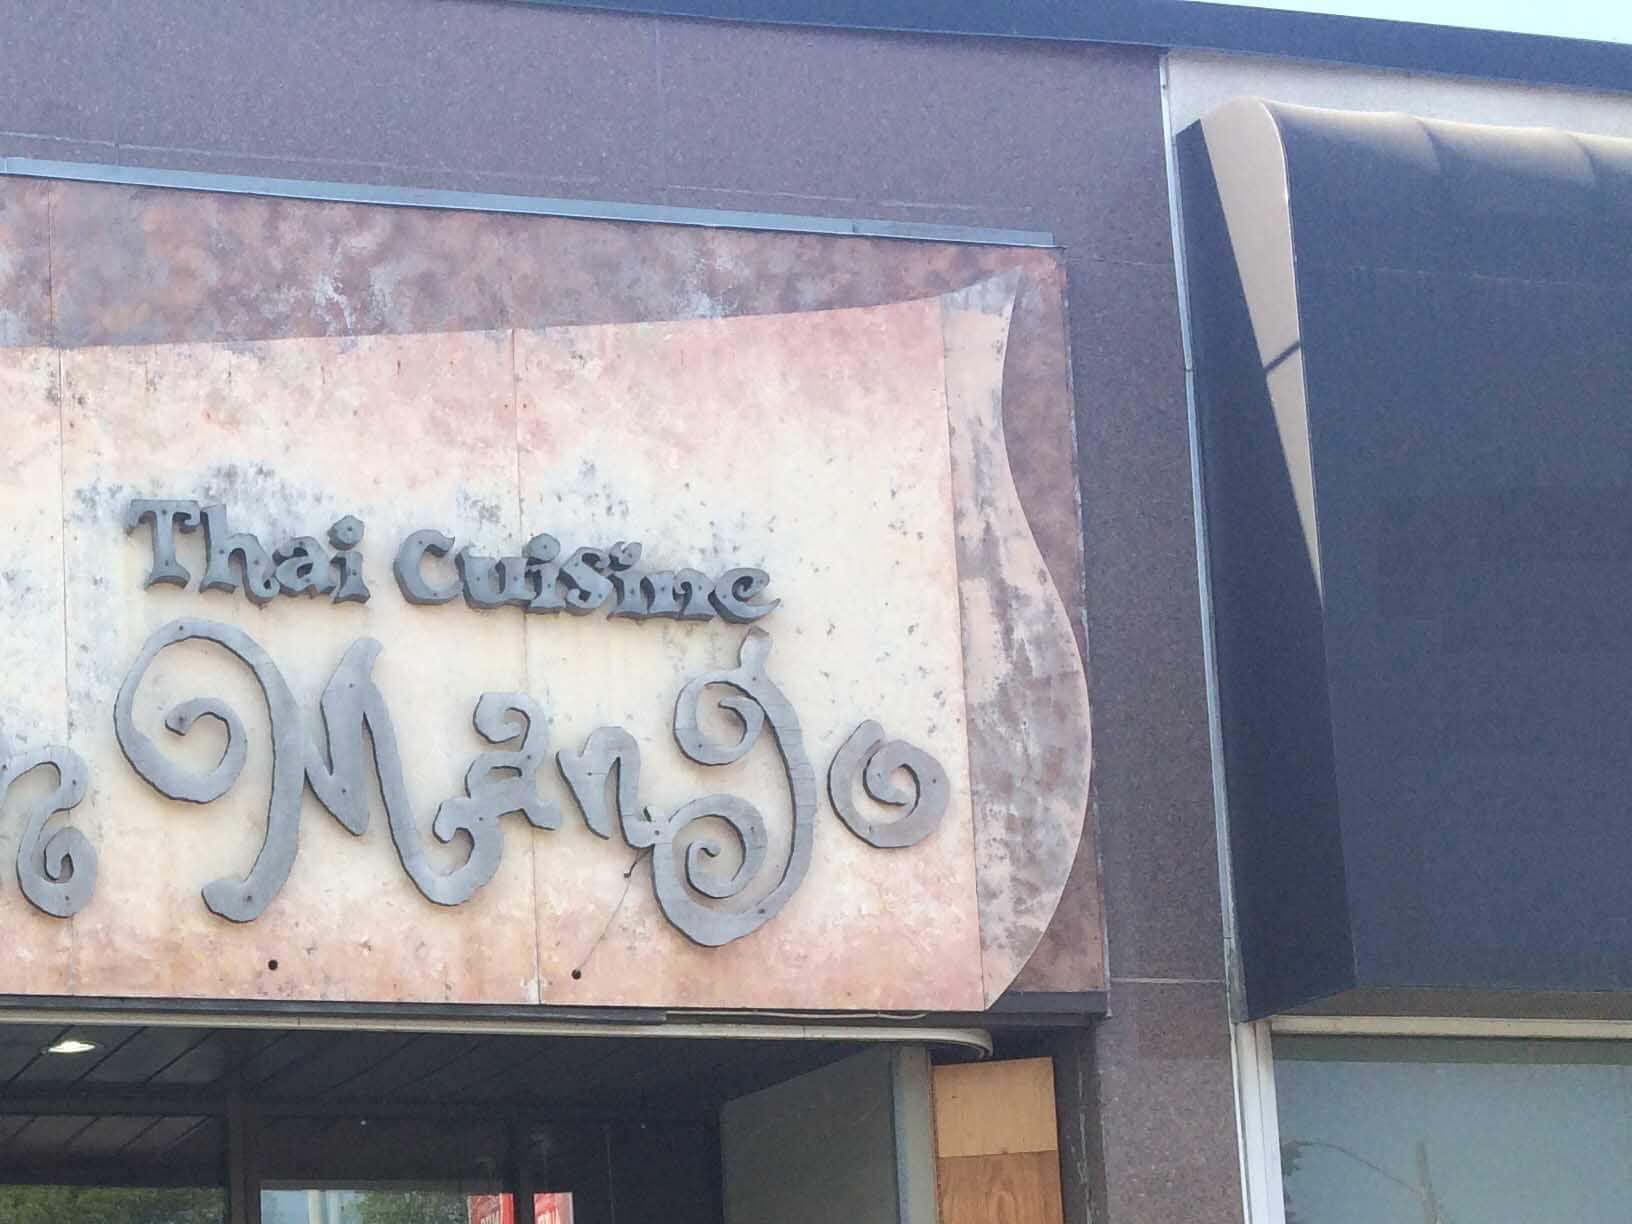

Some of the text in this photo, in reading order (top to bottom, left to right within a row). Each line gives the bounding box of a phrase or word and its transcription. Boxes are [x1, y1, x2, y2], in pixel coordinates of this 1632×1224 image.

[125, 499, 781, 625] Thai Cuisine
[113, 616, 950, 948] Mango
